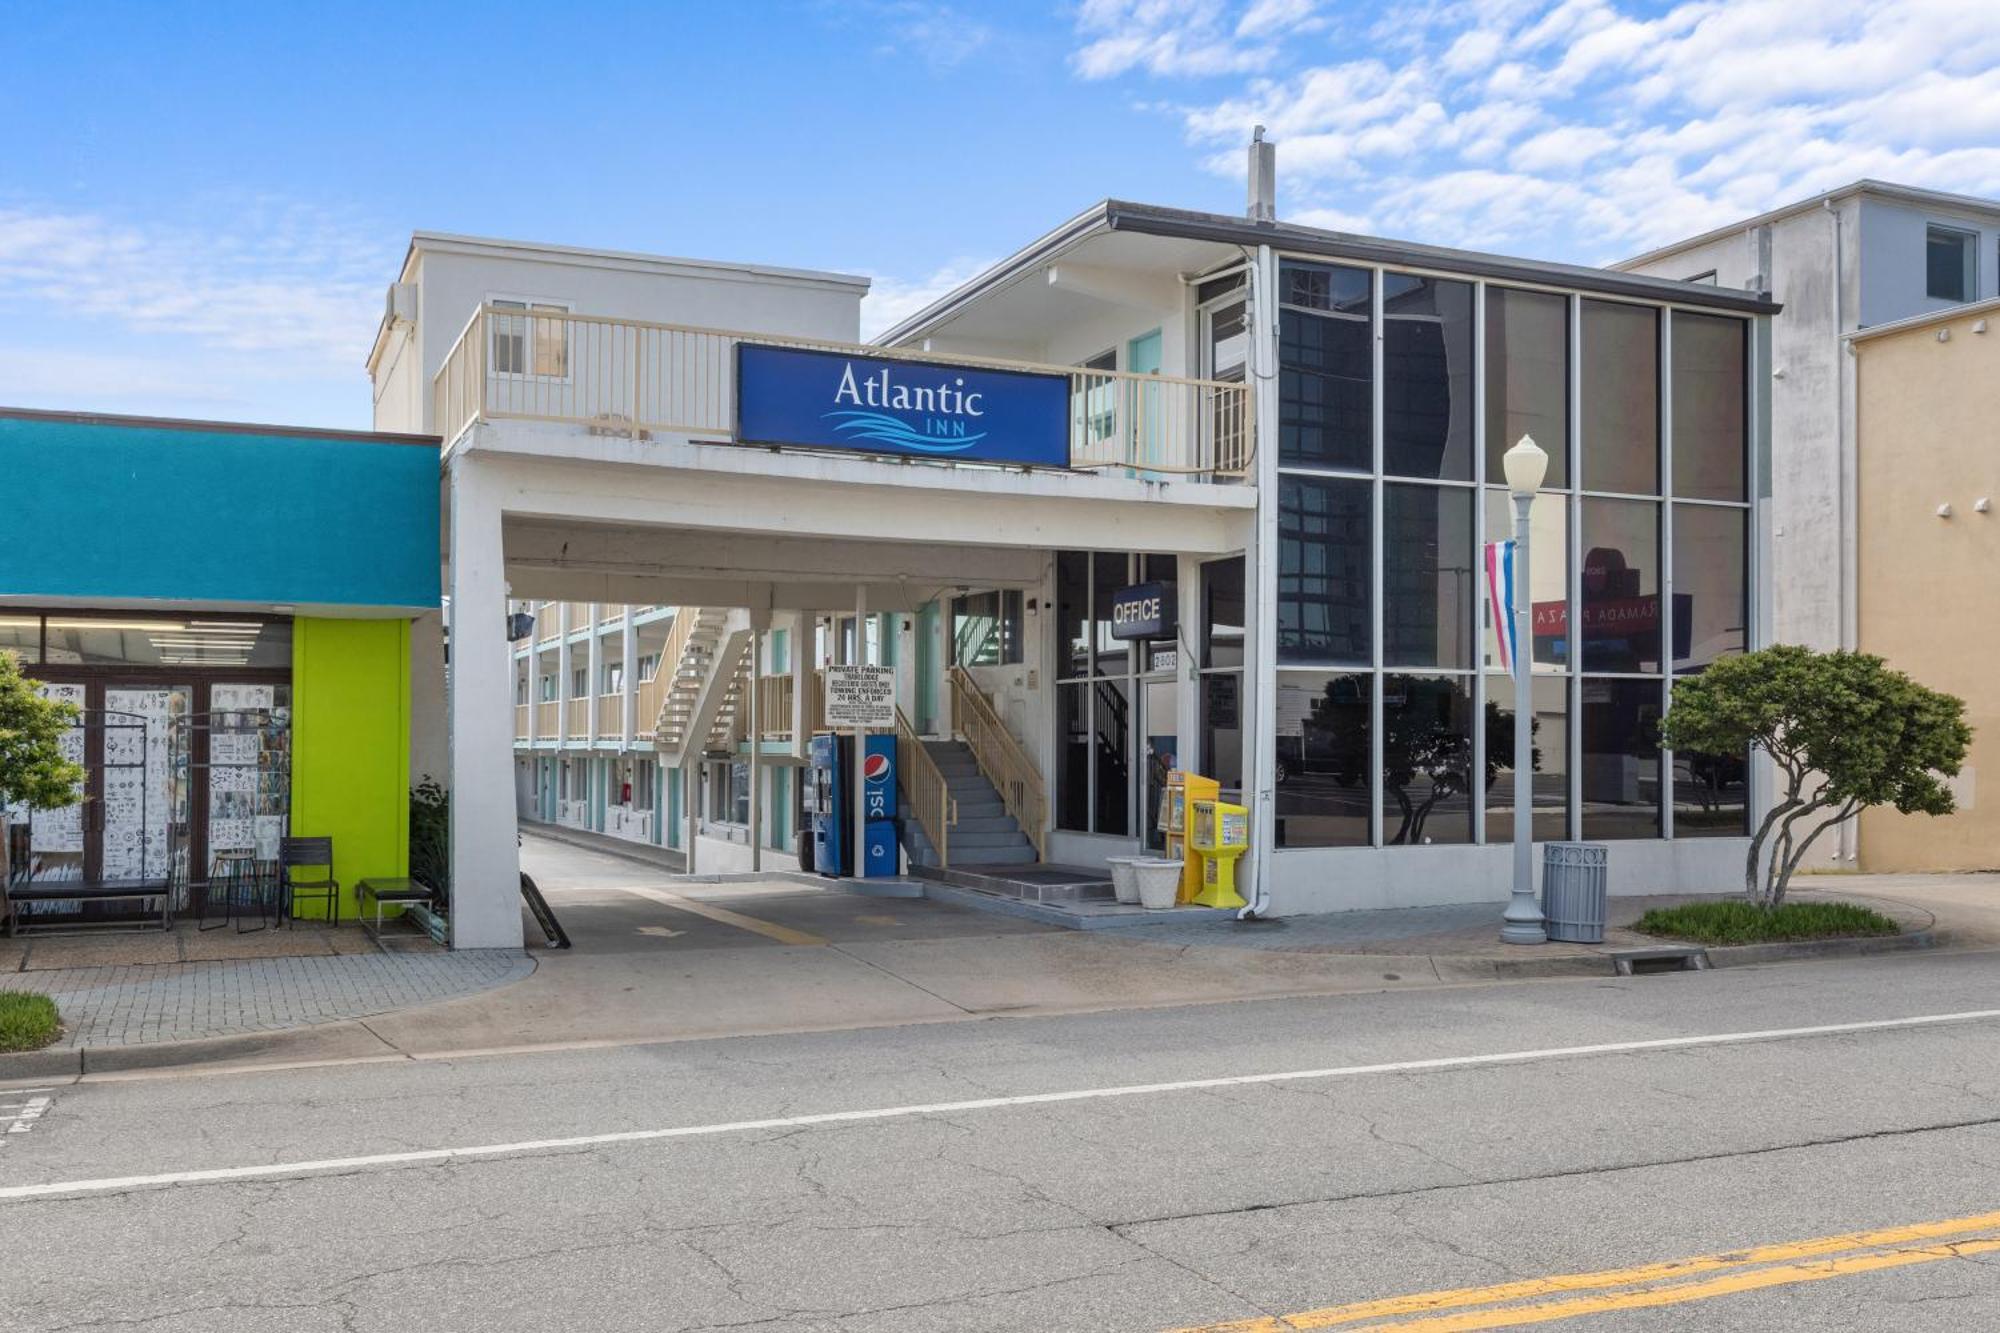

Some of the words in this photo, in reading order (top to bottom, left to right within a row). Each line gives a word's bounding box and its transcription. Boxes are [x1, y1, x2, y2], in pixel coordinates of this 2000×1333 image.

[834, 361, 984, 417] Atlantic
[926, 418, 966, 437] INN
[1113, 598, 1161, 624] OFFICE
